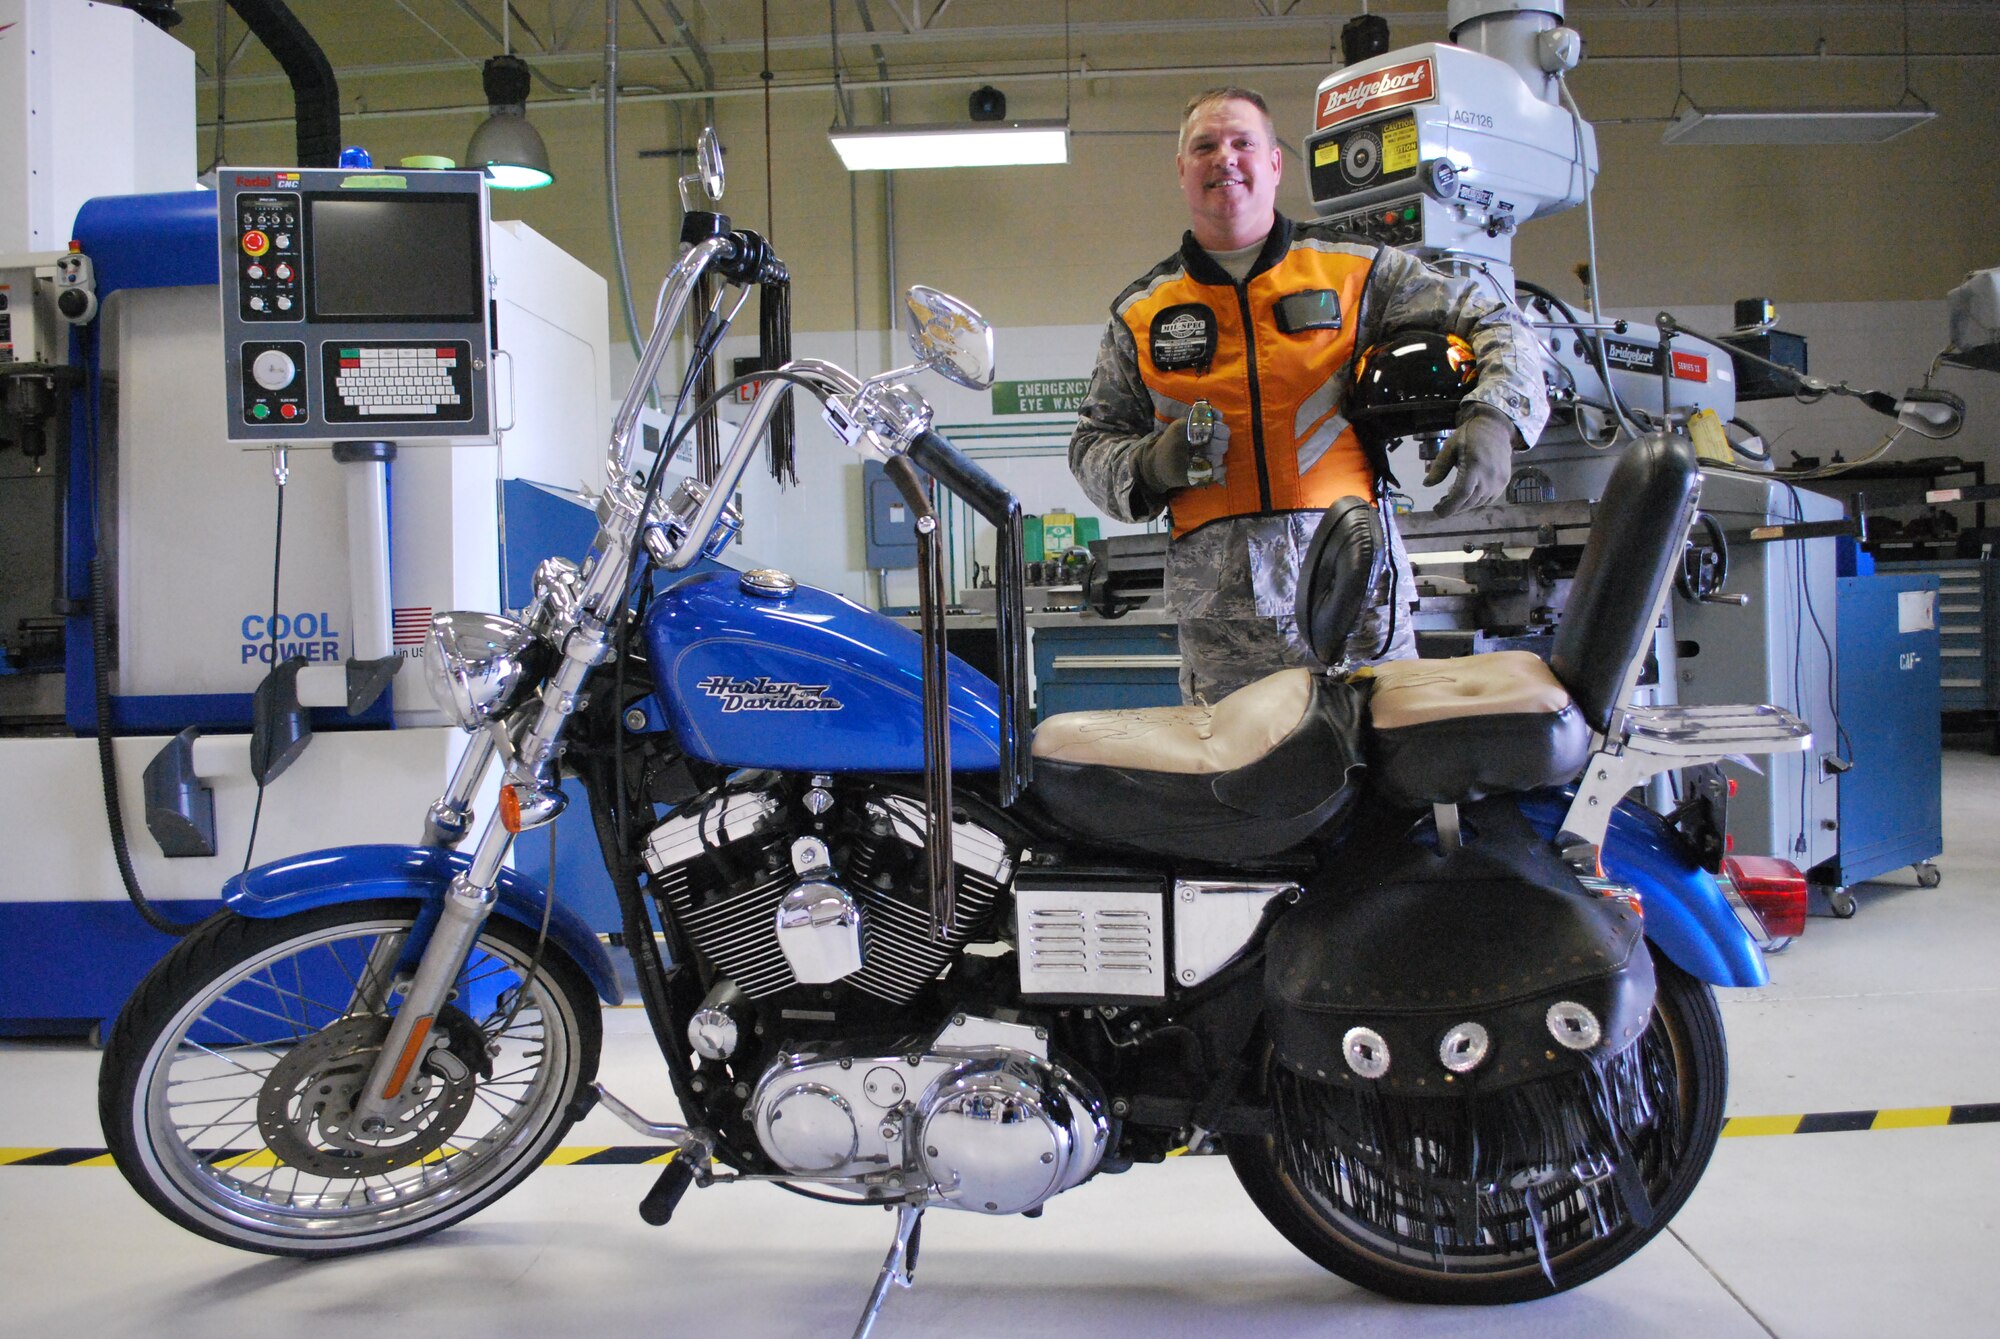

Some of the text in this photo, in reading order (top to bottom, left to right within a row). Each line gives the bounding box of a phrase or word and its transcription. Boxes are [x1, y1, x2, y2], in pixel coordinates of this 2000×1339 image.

[1324, 65, 1424, 112] Bridgeport
[1383, 119, 1415, 133] CAUTION
[1454, 110, 1494, 128] AG7126
[278, 180, 299, 188] CNC
[1164, 321, 1205, 331] MIL-SPEC
[1609, 344, 1654, 368] Bridgeport
[1677, 361, 1694, 372] SERIES
[1017, 382, 1090, 397] EMERGENCY
[1020, 398, 1044, 411] EYE
[241, 612, 339, 641] COOL
[241, 641, 339, 664] POWER
[411, 647, 424, 658] US
[698, 676, 815, 698] Harley
[722, 694, 842, 712] Davidson
